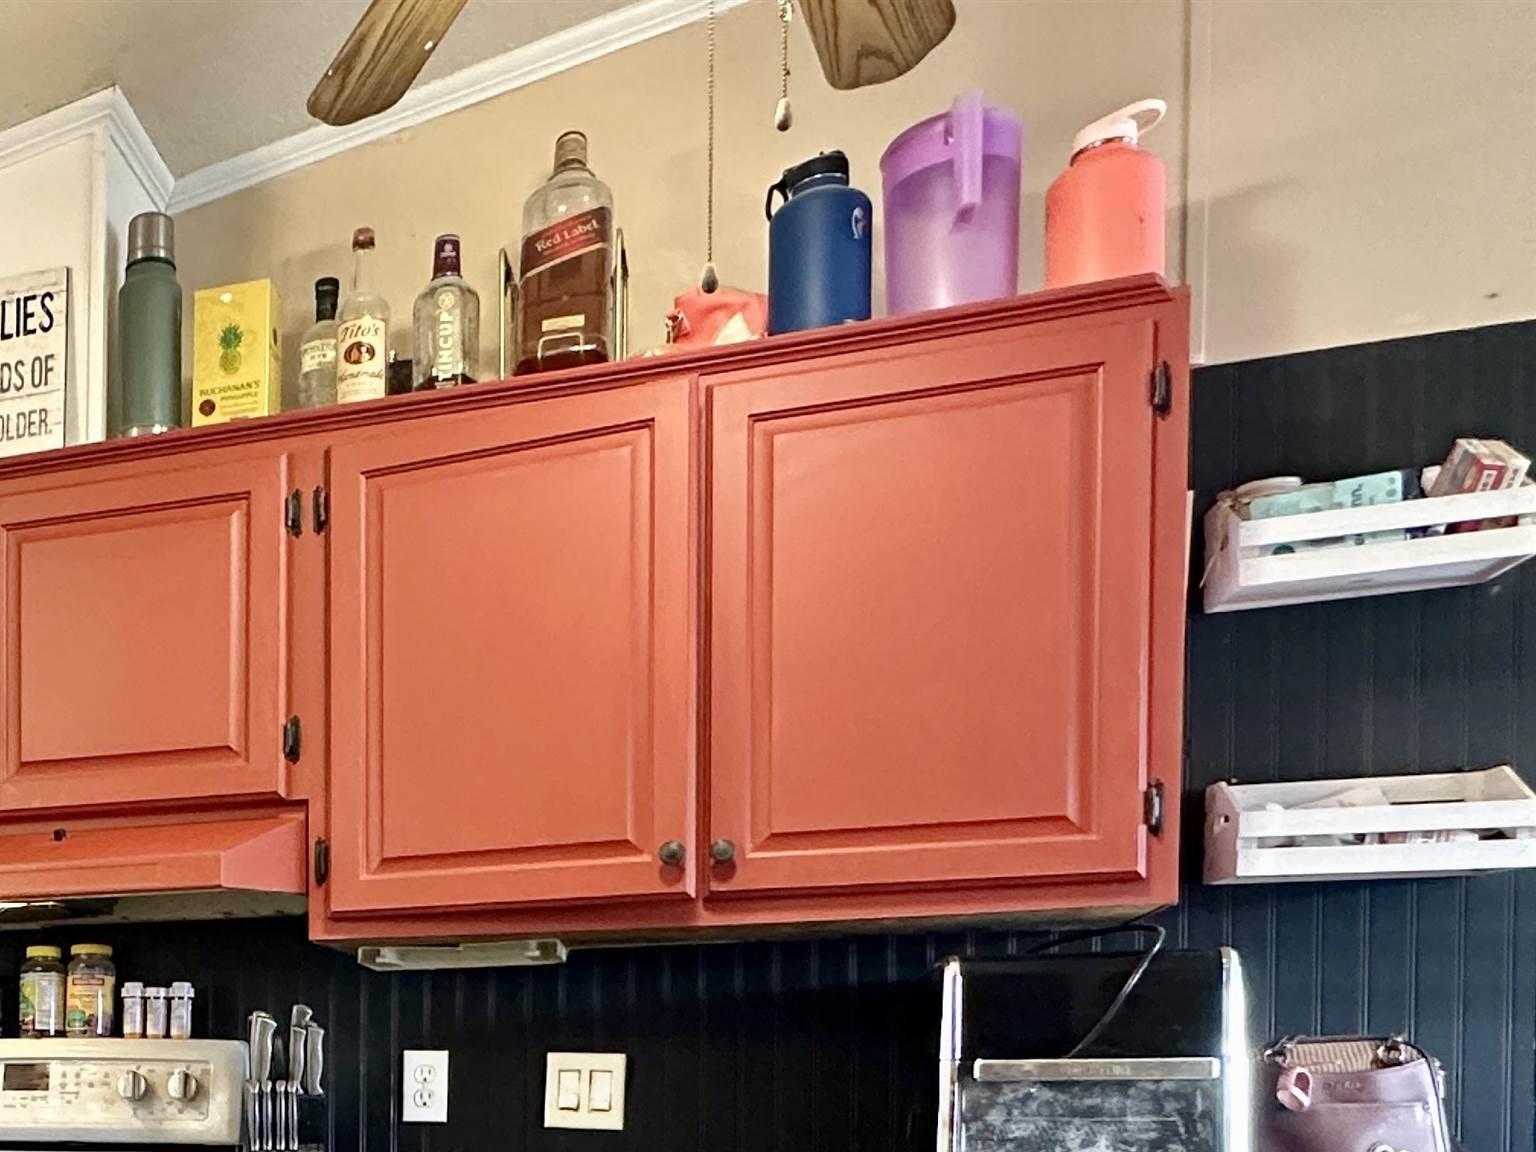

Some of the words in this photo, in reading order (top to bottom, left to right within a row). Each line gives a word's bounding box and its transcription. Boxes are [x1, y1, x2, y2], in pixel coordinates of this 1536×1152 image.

[535, 233, 562, 252] Red
[563, 219, 600, 240] Label
[0, 291, 55, 341] LIES
[340, 323, 381, 343] Tito's
[31, 354, 55, 388] OF
